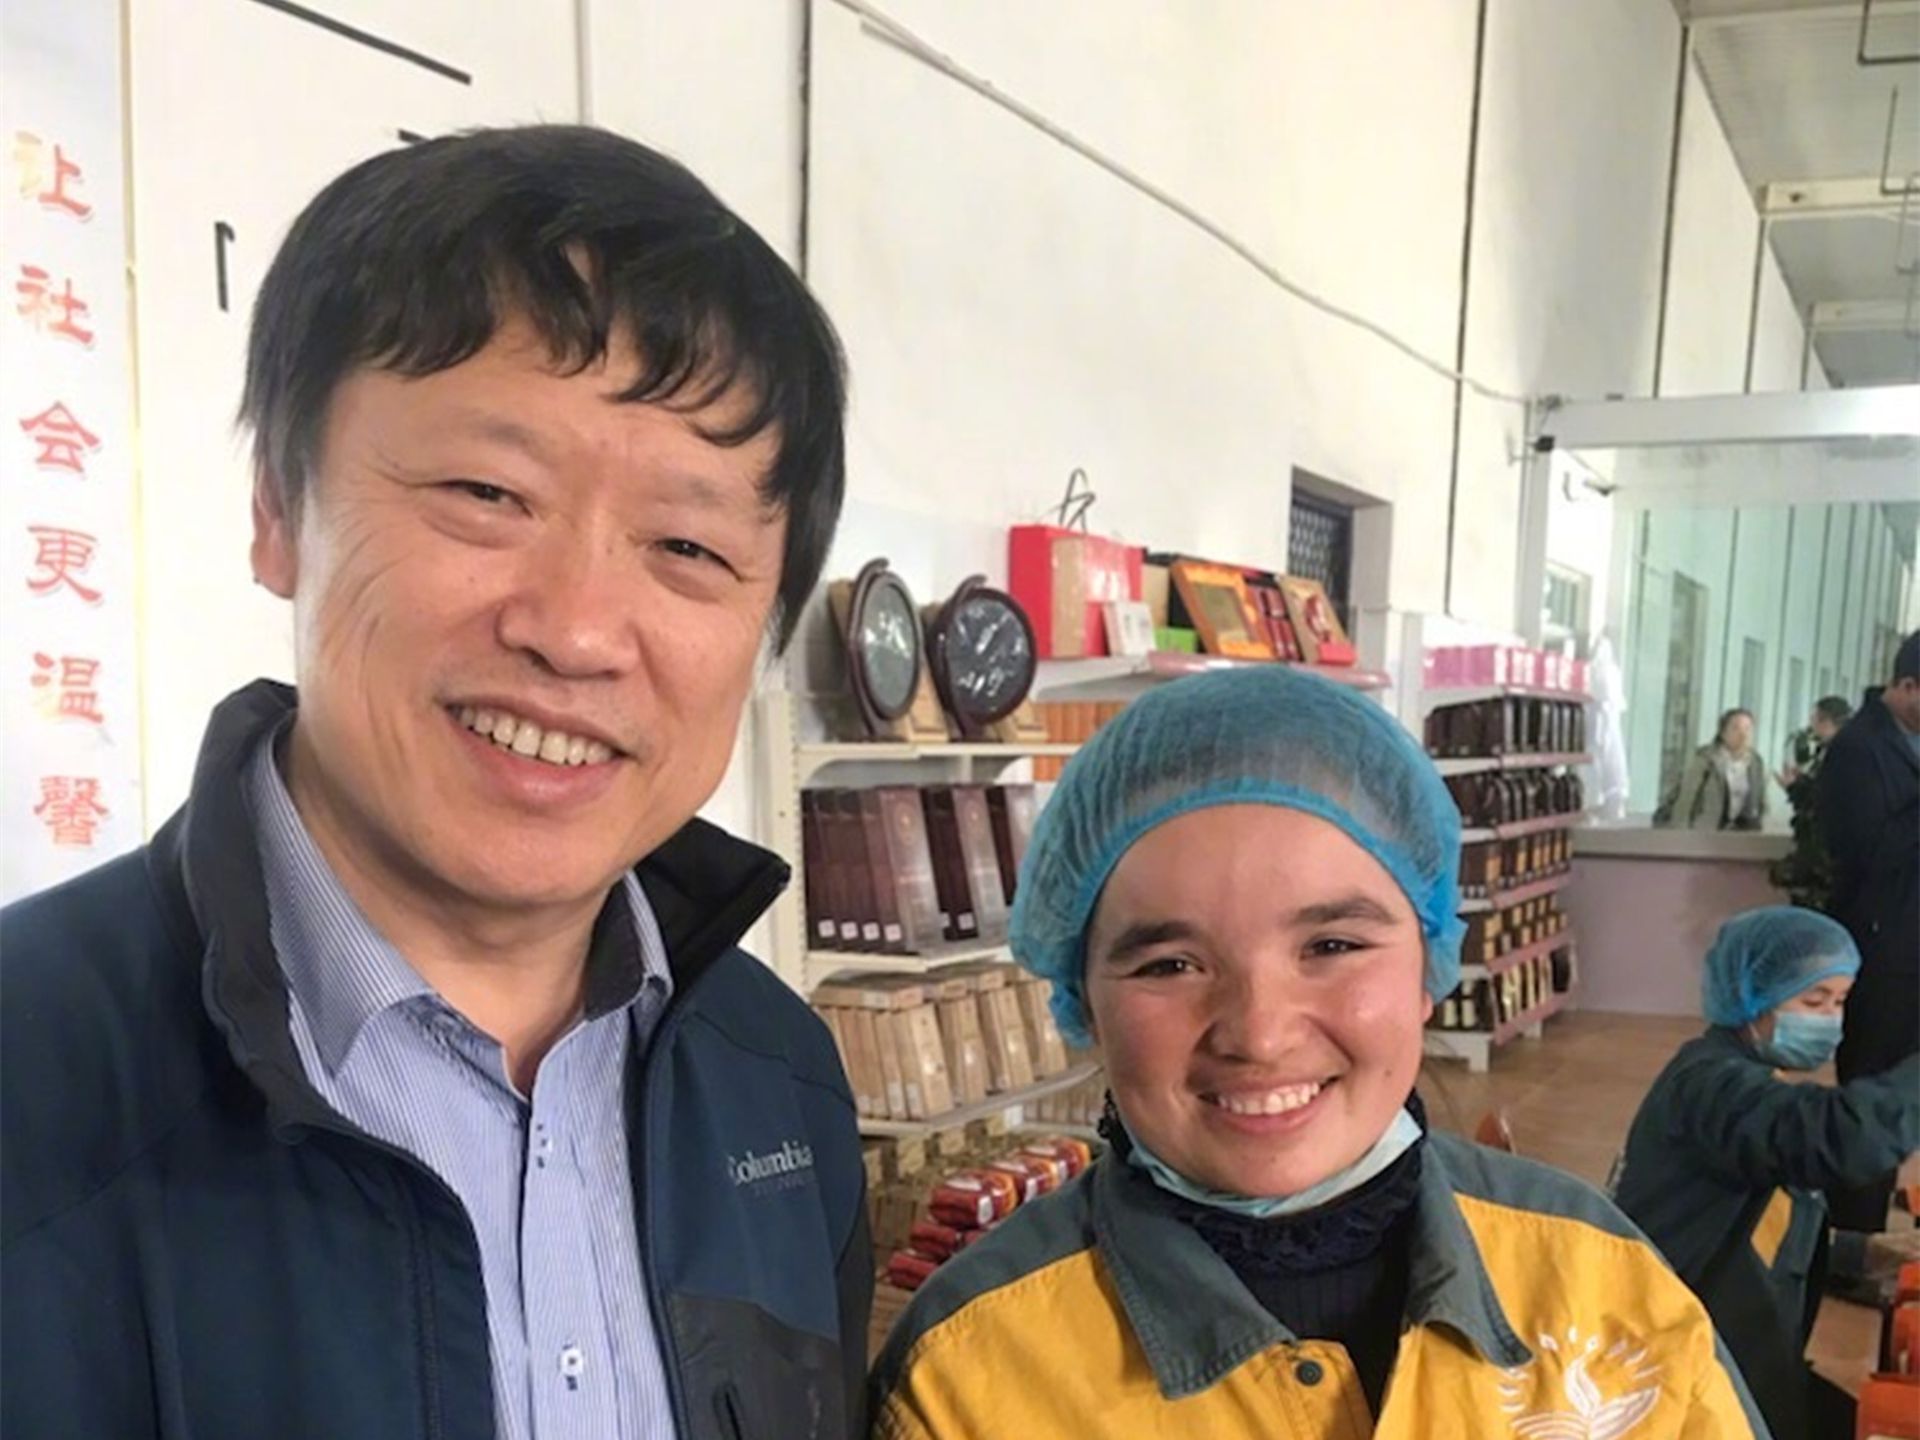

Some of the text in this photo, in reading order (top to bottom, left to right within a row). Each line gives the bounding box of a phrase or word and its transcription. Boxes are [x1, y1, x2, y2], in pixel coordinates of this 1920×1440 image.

[13, 131, 108, 846] 让社会更温馨
[727, 1141, 813, 1186] Columbia
